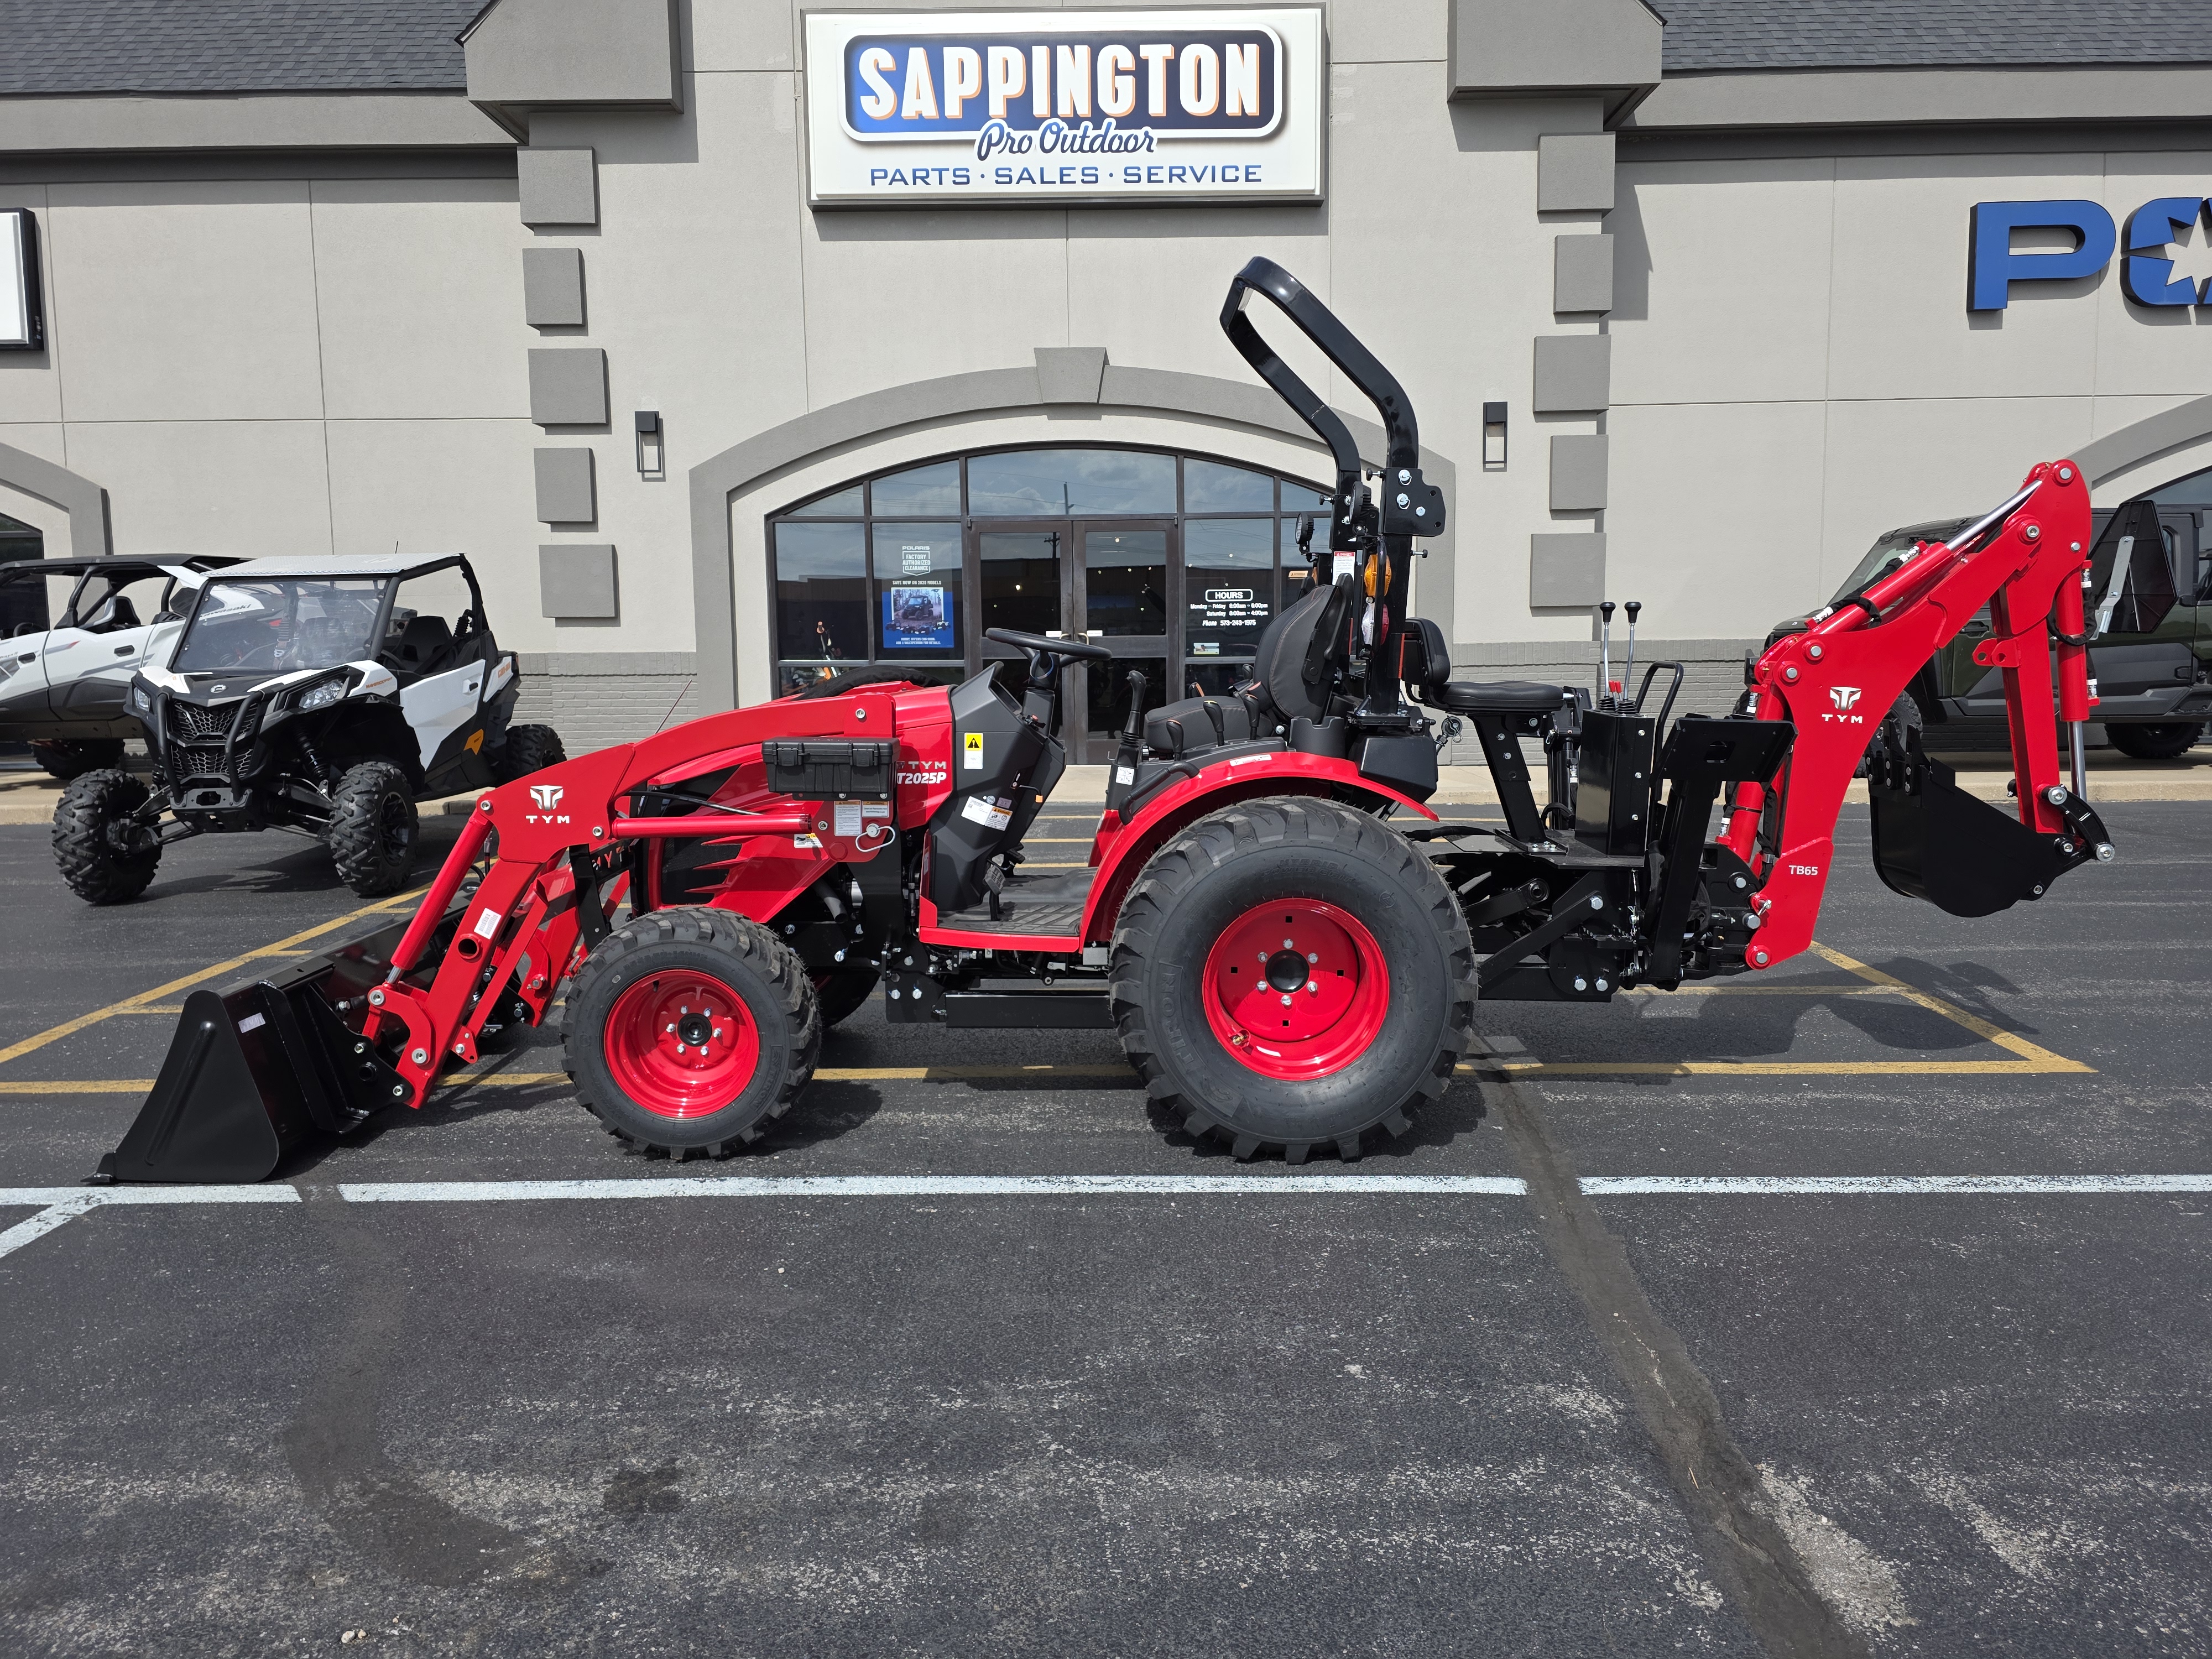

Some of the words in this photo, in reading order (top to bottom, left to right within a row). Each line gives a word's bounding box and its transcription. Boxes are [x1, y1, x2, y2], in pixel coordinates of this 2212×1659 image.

[859, 43, 1260, 119] SAPPINGTON
[977, 122, 1032, 161] Pro
[1039, 121, 1156, 154] Outdoor
[871, 168, 970, 186] PARTS
[995, 166, 1099, 185] SALES
[1124, 165, 1262, 184] SERVICE
[1822, 713, 1863, 724] TYM
[908, 761, 946, 769] TYM
[896, 771, 947, 784] T2025P
[525, 815, 570, 824] TYM
[1788, 865, 1818, 875] TB65
